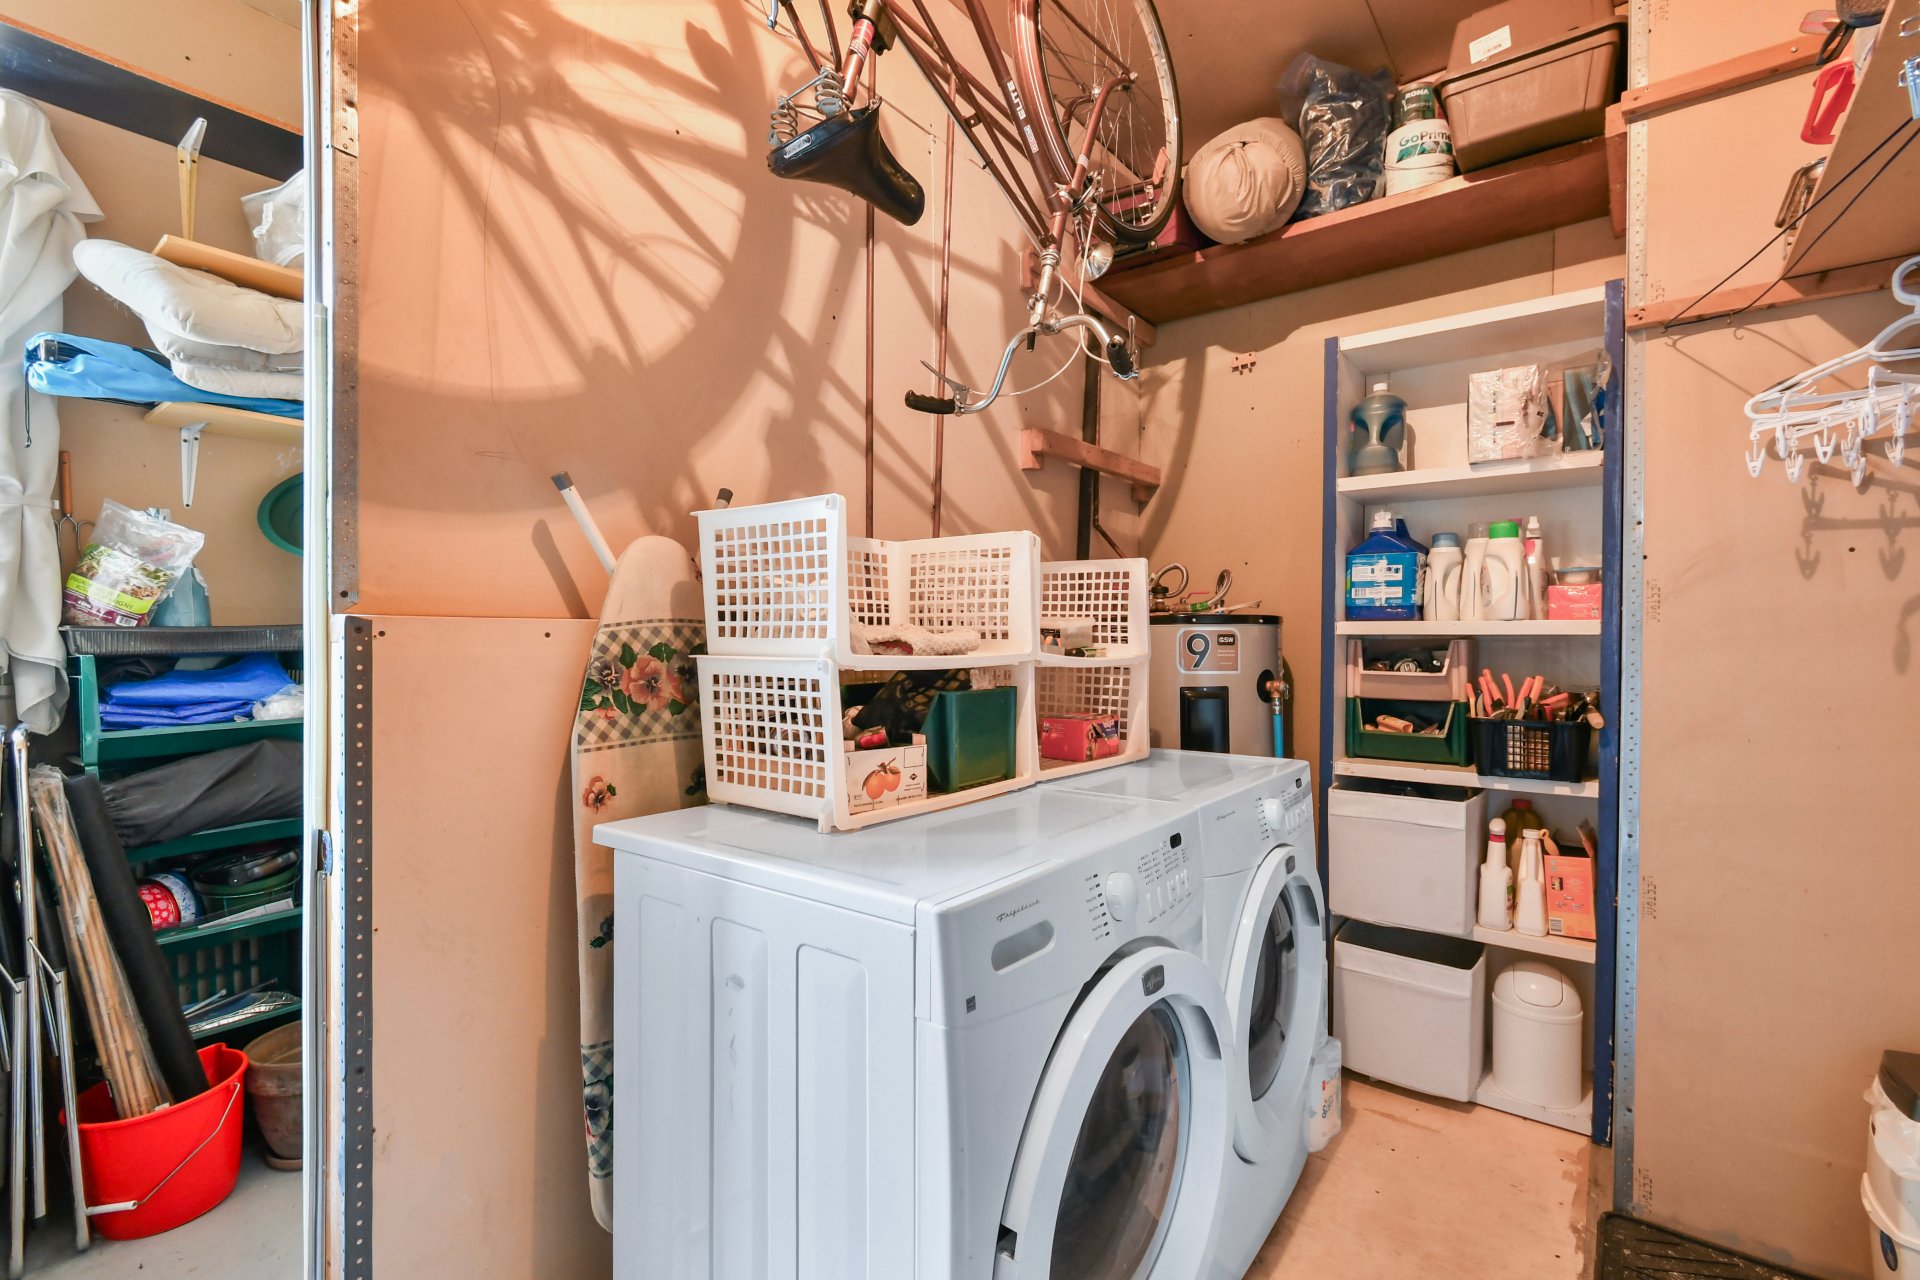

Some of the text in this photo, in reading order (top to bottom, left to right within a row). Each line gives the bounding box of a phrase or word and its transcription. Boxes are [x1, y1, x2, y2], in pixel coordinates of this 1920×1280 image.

[1007, 80, 1026, 119] ELITE
[1405, 88, 1429, 99] RONA
[1186, 632, 1211, 669] 9
